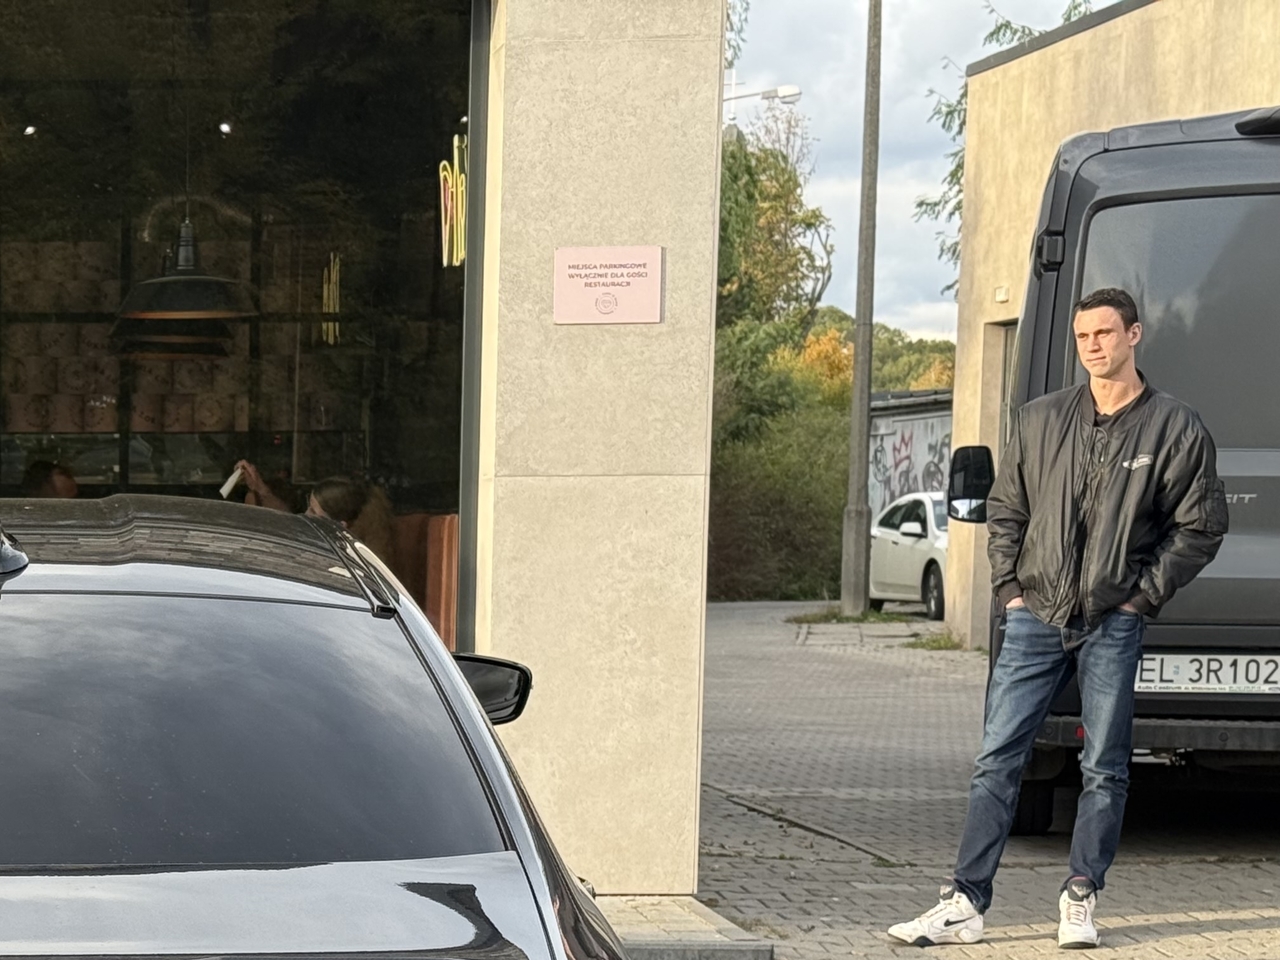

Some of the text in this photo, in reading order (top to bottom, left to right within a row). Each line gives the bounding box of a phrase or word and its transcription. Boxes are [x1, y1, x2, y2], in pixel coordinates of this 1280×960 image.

[567, 262, 648, 271] MIEJSCA PARKINGOWE
[567, 270, 648, 280] WYŁĄCZNIE DLA GOŚCI
[1138, 656, 1279, 685] EL 3R102
